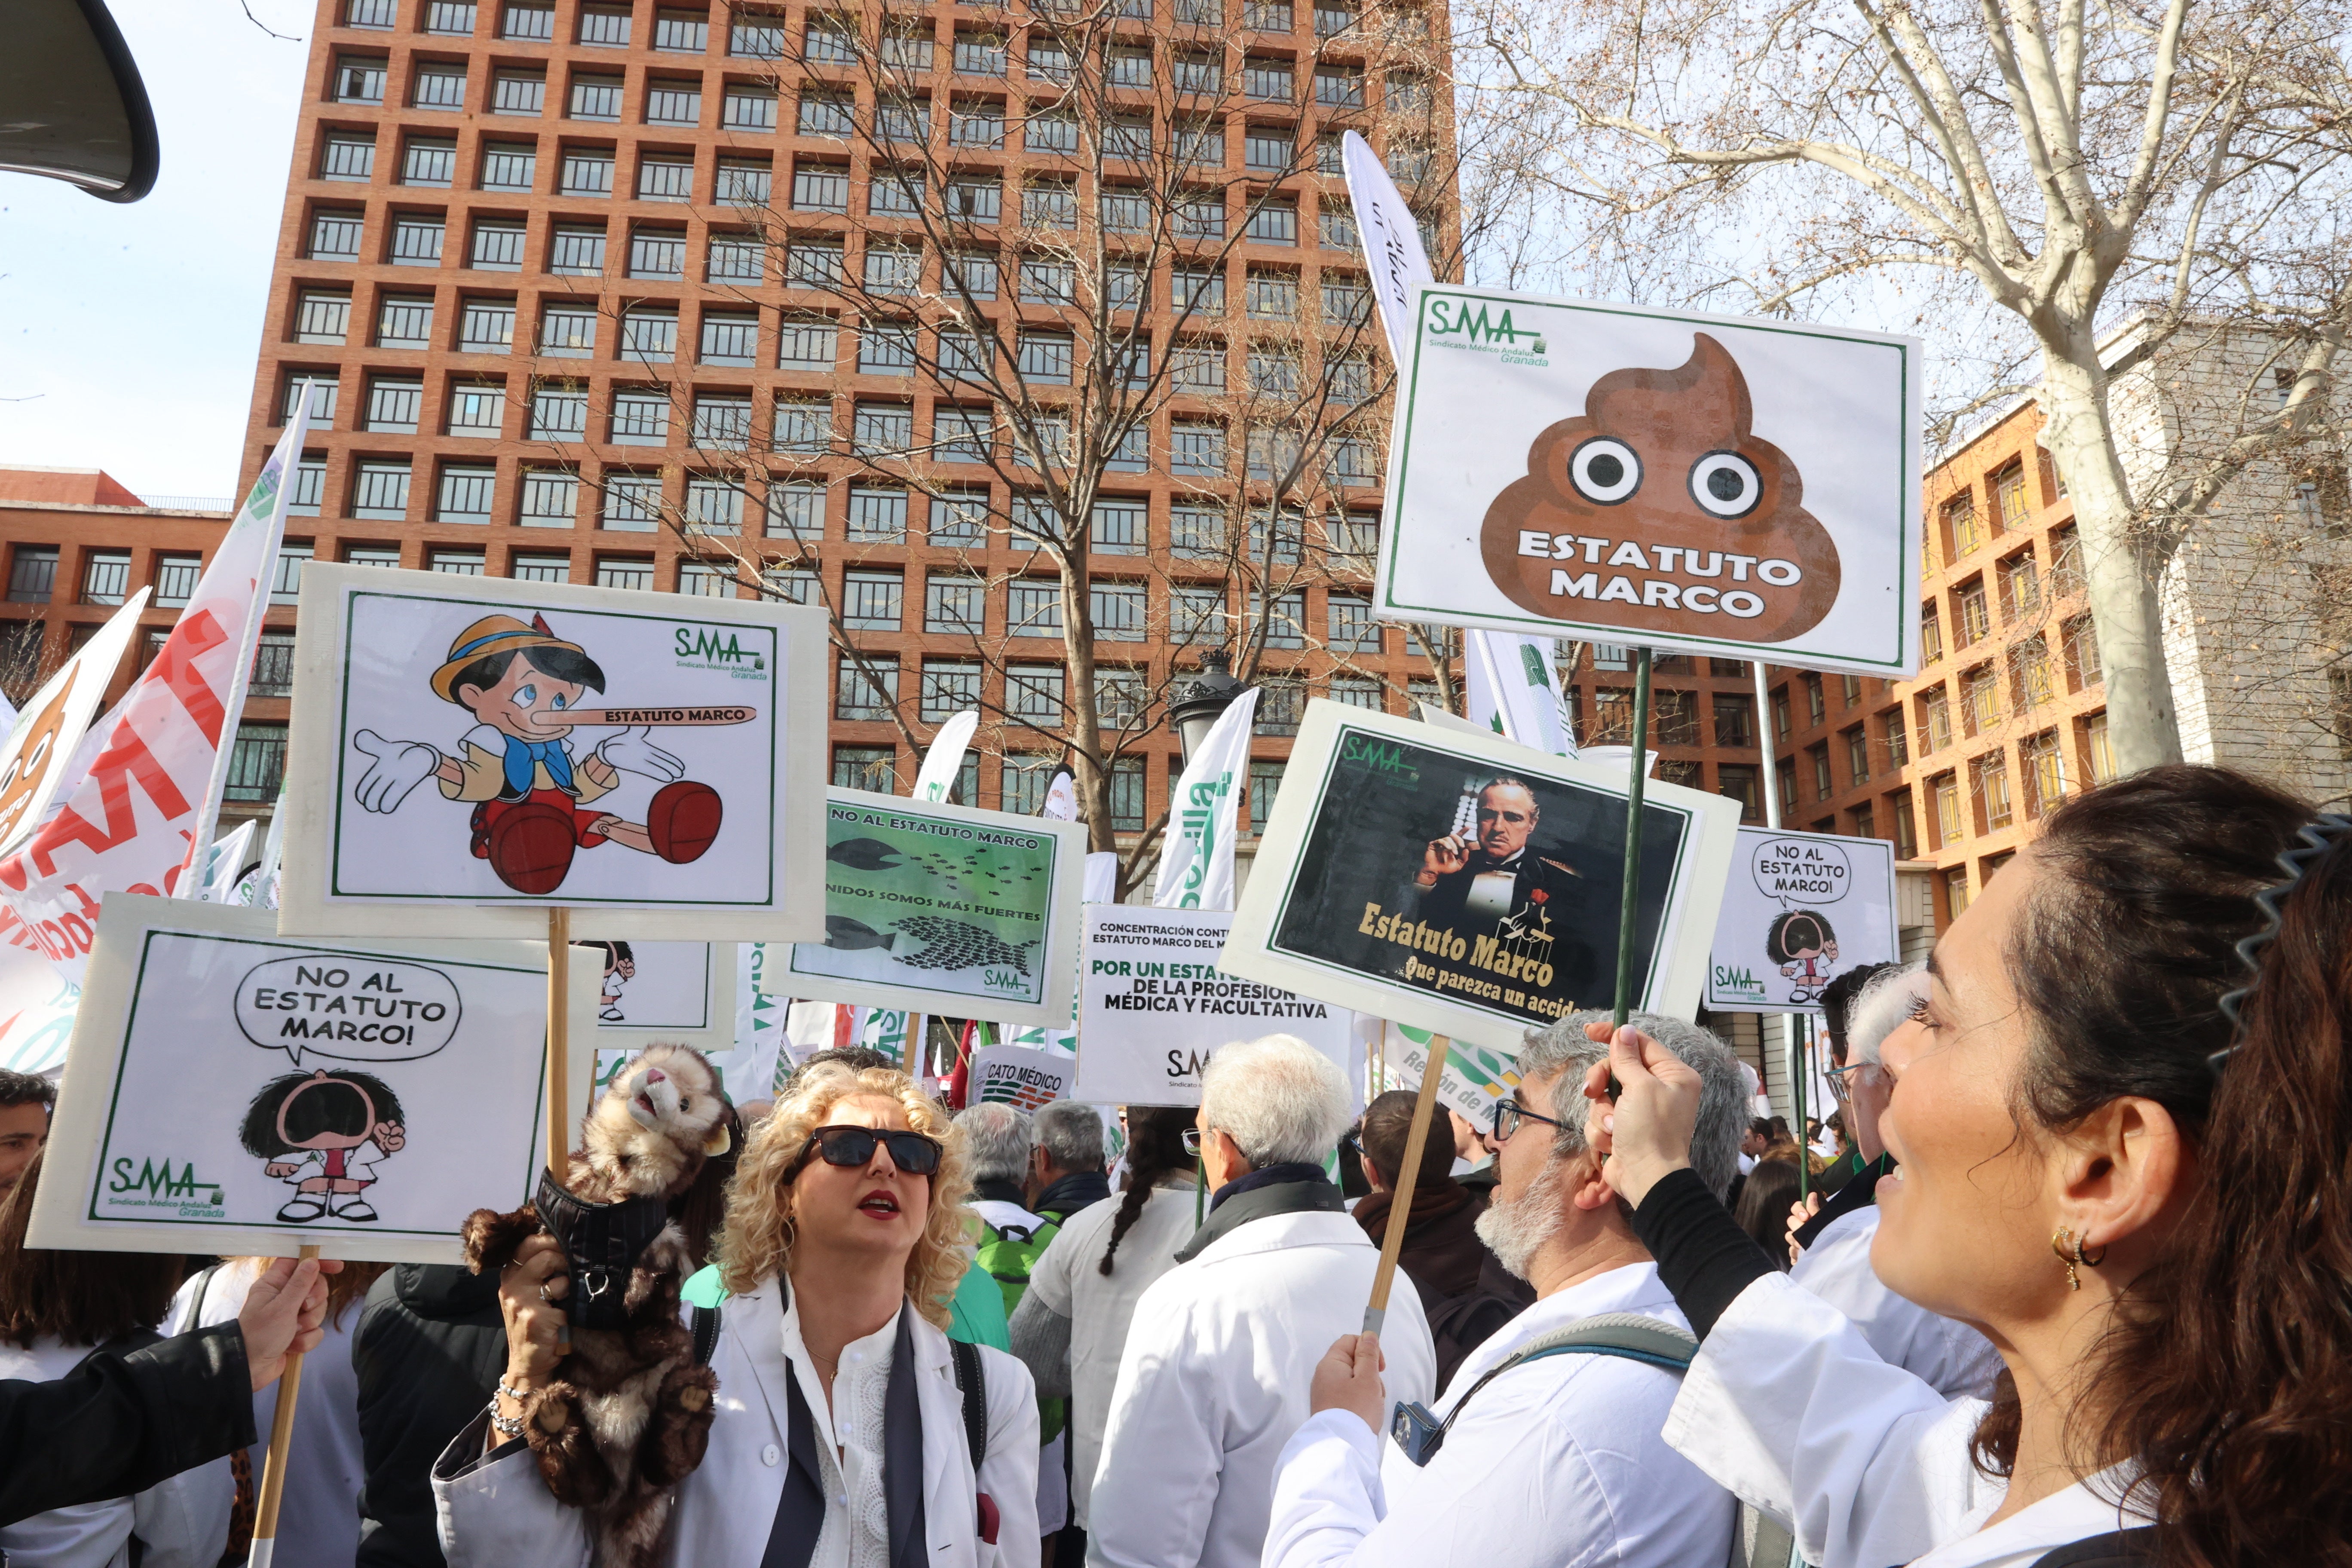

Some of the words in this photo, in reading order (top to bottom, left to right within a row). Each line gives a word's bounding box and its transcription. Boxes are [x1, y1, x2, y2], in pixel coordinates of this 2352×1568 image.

[1429, 300, 1515, 343] SMA
[1429, 340, 1467, 350] Sindicato
[1469, 343, 1499, 353] Médico
[1501, 347, 1534, 357] Andaluz
[1501, 354, 1548, 367] Granada
[1517, 529, 1803, 587] ESTATUTO
[1550, 568, 1765, 619] MARCO
[675, 627, 741, 664] SMA
[676, 661, 705, 669] Sindicato
[707, 663, 730, 671] Médico
[731, 671, 767, 681] Granada
[605, 710, 684, 723] ESTATUTO
[689, 709, 746, 721] MARCO
[1342, 736, 1401, 773] SMA
[830, 808, 858, 822] NO
[862, 814, 885, 827] AL
[889, 818, 973, 840] ESTATUTO
[977, 831, 1038, 850] MARCO
[1776, 845, 1800, 859] NO
[1805, 848, 1824, 861] AL
[1760, 860, 1844, 878] ESTATUTO
[1775, 878, 1833, 894] MARCO!
[826, 883, 875, 898] NIDOS
[879, 891, 933, 906] SOMOS
[937, 899, 970, 912] MÁS
[974, 905, 1041, 922] FUERTES
[1093, 934, 1150, 945] ESTATUTO
[1152, 938, 1192, 948] MARCO
[1194, 940, 1215, 948] DEL
[1100, 923, 1194, 937] CONCENTRACIÓN
[1358, 901, 1467, 961] Estatuto
[1092, 960, 1131, 976] POR
[1136, 962, 1164, 978] UN
[1469, 934, 1554, 987] Marco
[295, 965, 350, 988] NO
[361, 973, 403, 993] AL
[984, 969, 1019, 990] SMA
[1133, 979, 1158, 994] DE
[1164, 980, 1186, 995] LA
[1406, 955, 1433, 981] Que
[1436, 970, 1502, 1001] parezca
[1504, 988, 1525, 1008] un
[1715, 965, 1753, 990] SMA
[254, 988, 446, 1022] ESTATUTO
[1105, 991, 1179, 1012] MÉDICA
[1183, 998, 1196, 1013] Y
[1200, 998, 1328, 1019] FACULTATIVA
[281, 1017, 413, 1046] MARCO!
[1167, 1047, 1210, 1081] SM
[988, 1064, 1016, 1079] CATO
[1017, 1066, 1062, 1091] MÉDICO
[1457, 1090, 1481, 1110] de
[110, 1156, 194, 1200] SMA
[108, 1197, 145, 1206] Sindicato
[148, 1199, 178, 1207] Médico
[179, 1207, 225, 1218] Granada
